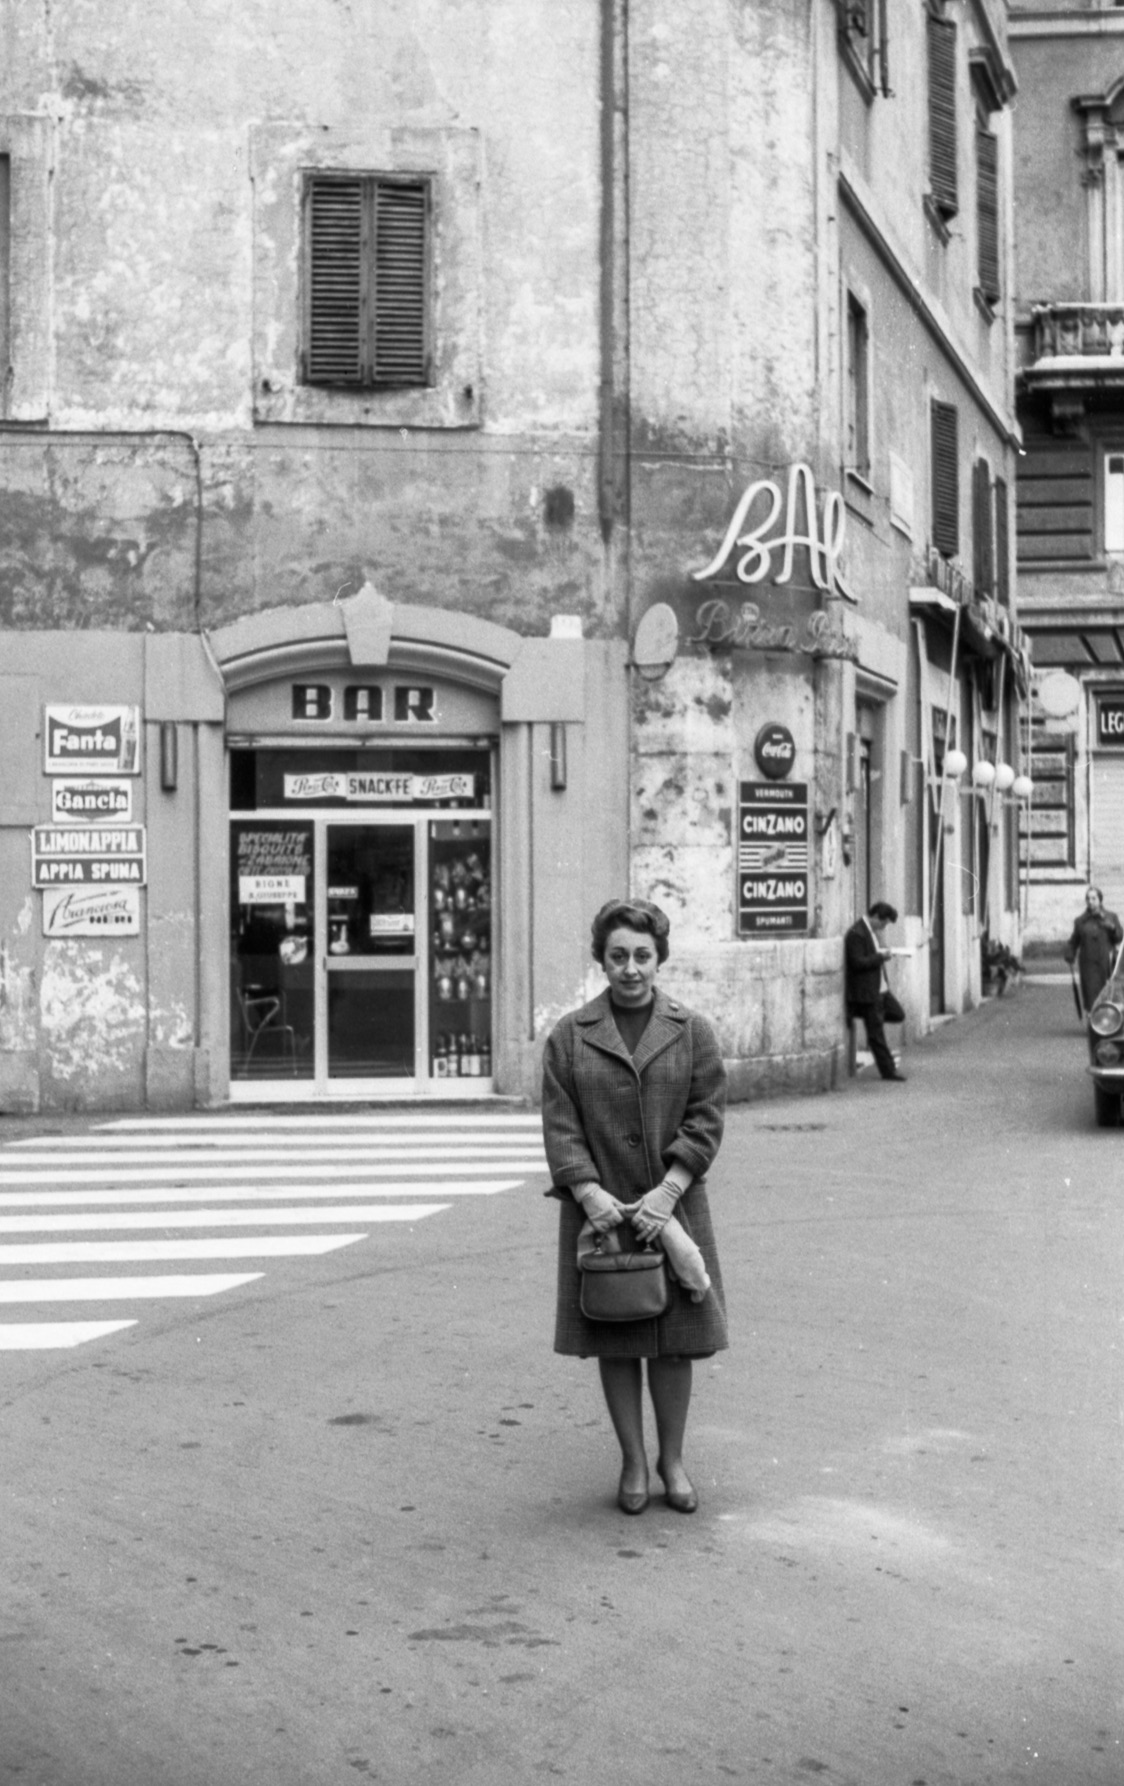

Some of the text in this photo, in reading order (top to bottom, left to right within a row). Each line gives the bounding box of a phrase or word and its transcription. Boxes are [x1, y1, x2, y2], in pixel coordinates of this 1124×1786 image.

[292, 684, 437, 722] BAR
[53, 729, 117, 755] Fanta
[56, 791, 128, 810] Gancia
[743, 814, 805, 835] CINZANO
[40, 832, 138, 852] LIMONAPPIA
[40, 863, 140, 880] APPIA SPUMA
[743, 879, 805, 900] CINZANO
